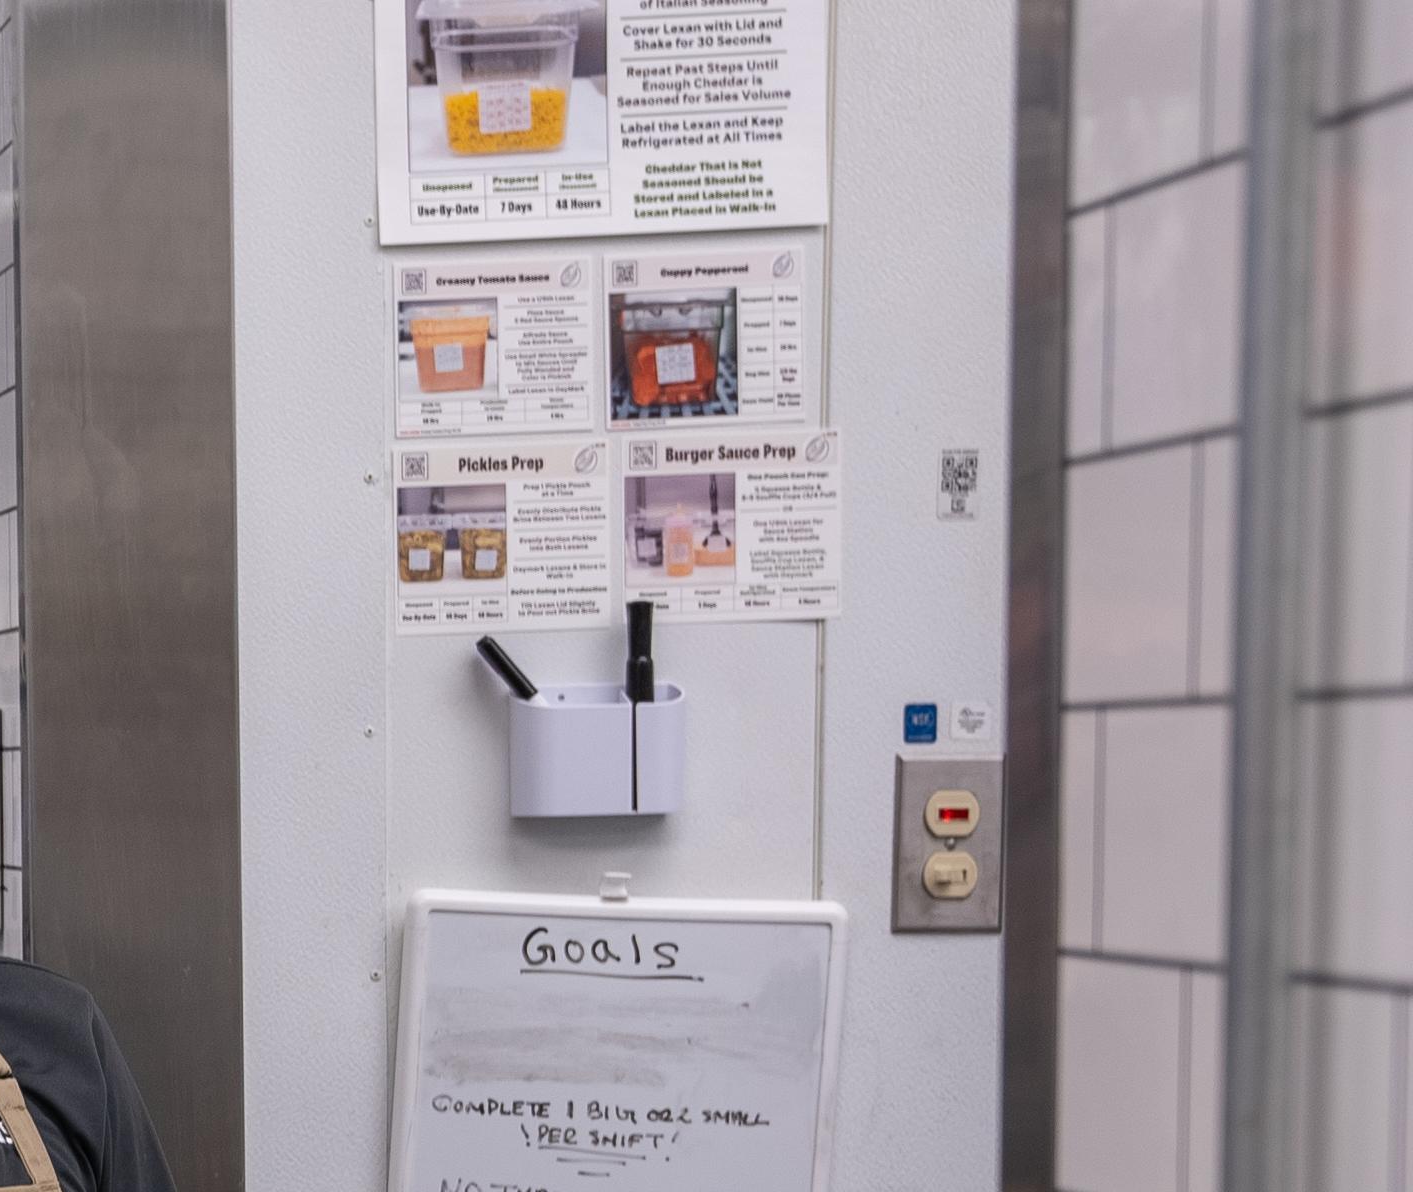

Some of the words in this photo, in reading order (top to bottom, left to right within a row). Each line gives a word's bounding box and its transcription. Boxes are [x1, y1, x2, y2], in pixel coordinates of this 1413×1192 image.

[623, 25, 659, 36] Cover
[663, 22, 701, 34] Lexan
[704, 21, 731, 32] with
[736, 19, 754, 31] Lid
[759, 17, 782, 29] and
[634, 39, 672, 51] Shake
[676, 37, 693, 48] for
[698, 36, 713, 47] 30
[717, 34, 771, 46] Seconds
[627, 65, 671, 78] Repeat
[675, 64, 703, 75] Past
[708, 62, 743, 75] Steps
[747, 59, 778, 71] Until
[642, 79, 690, 92] Enough
[694, 77, 748, 89] Cheddar
[617, 94, 679, 108] Seasoned
[683, 93, 700, 104] for
[705, 91, 738, 103] Sales
[742, 89, 791, 100] Volume
[621, 121, 655, 134] Label
[659, 120, 678, 131] the
[683, 120, 720, 130] Lexan
[724, 117, 747, 128] and
[751, 116, 783, 127] Keep
[622, 133, 703, 149] Refrigerated
[708, 134, 719, 143] at
[723, 132, 739, 142] All
[744, 130, 782, 141] Times
[645, 163, 696, 174] Cheddar
[699, 161, 725, 171] That
[742, 159, 762, 169] Not
[643, 177, 701, 189] Seasoned
[705, 175, 745, 186] Should
[749, 175, 763, 183] be
[556, 199, 567, 209] 48
[571, 198, 601, 209] Hours
[634, 192, 674, 204] Stored
[677, 191, 699, 202] and
[703, 189, 749, 200] Labeled
[752, 189, 763, 197] in
[767, 189, 773, 197] a
[418, 204, 478, 218] Use-By-Date
[500, 202, 505, 213] 7
[508, 202, 532, 214] Days
[634, 208, 668, 218] Lexan
[672, 205, 712, 216] Placed
[715, 205, 726, 213] in
[665, 447, 715, 464] Burger
[718, 445, 759, 460] Sauce
[763, 443, 796, 460] Prep
[458, 457, 507, 473] Pickles
[511, 456, 543, 472] Prep
[521, 927, 680, 969] Goals
[432, 1094, 550, 1118] COMPLETE
[587, 1102, 637, 1126] BIG
[677, 1106, 692, 1124] 2
[702, 1109, 769, 1126] SMALL
